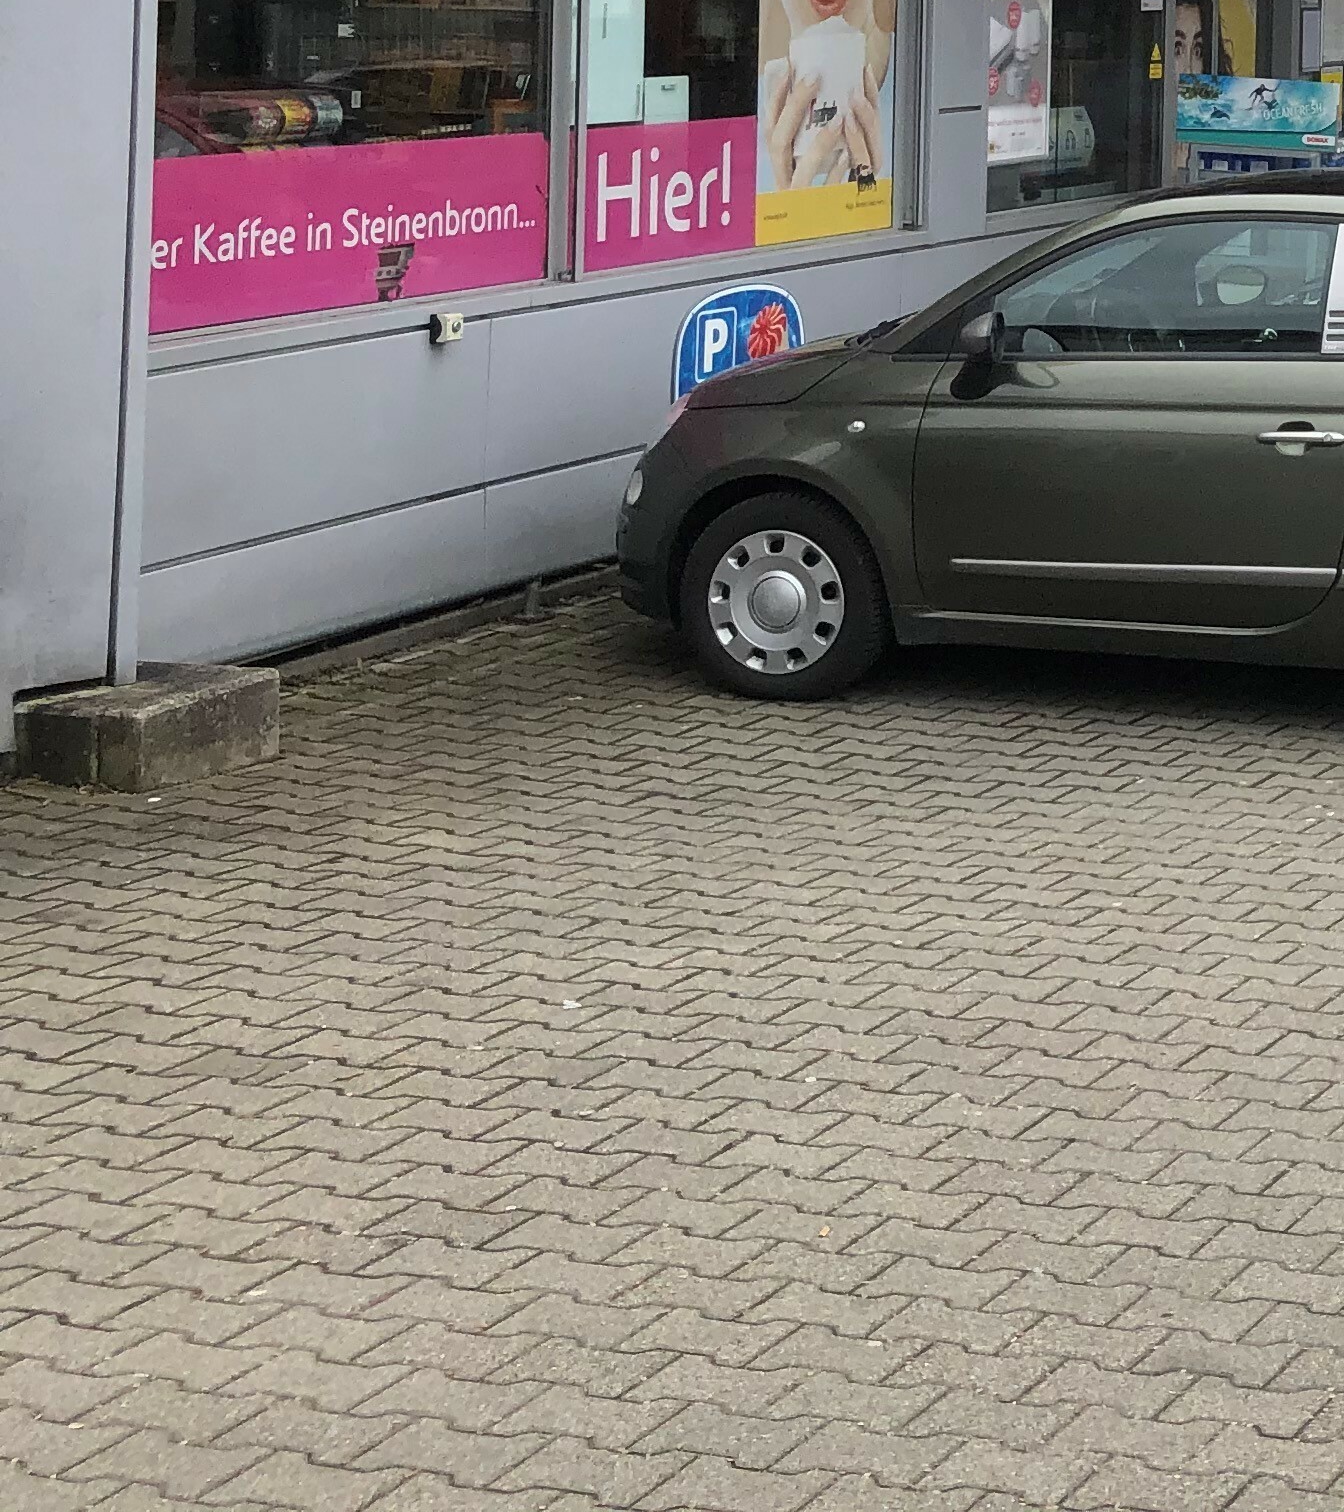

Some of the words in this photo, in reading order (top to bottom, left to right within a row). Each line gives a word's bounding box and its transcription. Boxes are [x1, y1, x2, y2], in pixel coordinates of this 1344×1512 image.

[1263, 106, 1294, 120] OCEAN
[1294, 101, 1323, 116] FRESH
[596, 140, 732, 243] Hier!
[193, 216, 296, 265] Kaffee
[306, 212, 332, 252] in
[703, 317, 729, 374] P
